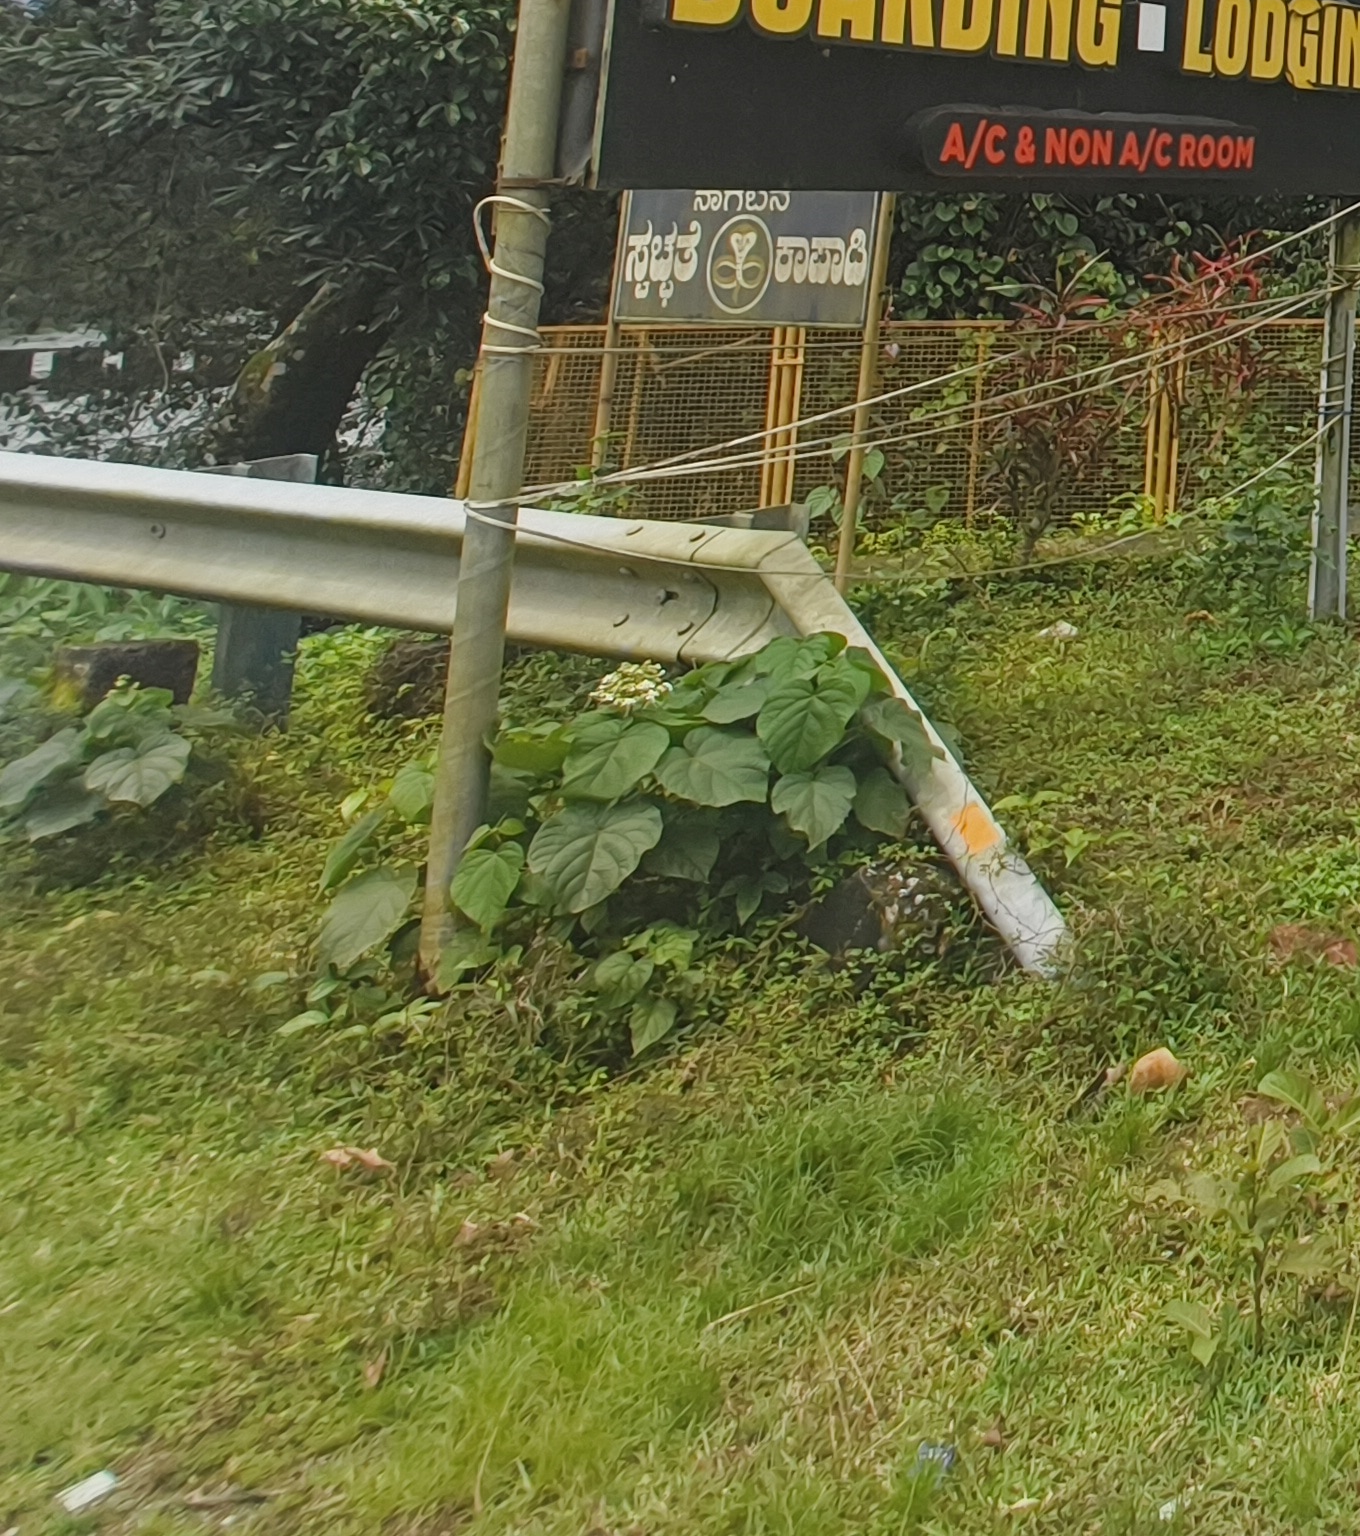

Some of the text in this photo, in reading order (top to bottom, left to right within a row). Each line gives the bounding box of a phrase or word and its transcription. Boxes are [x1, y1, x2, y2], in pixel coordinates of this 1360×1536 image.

[939, 119, 1255, 173] A/C & NON A/C ROOM
[774, 228, 869, 286] ಕಾಪಾಡಿ
